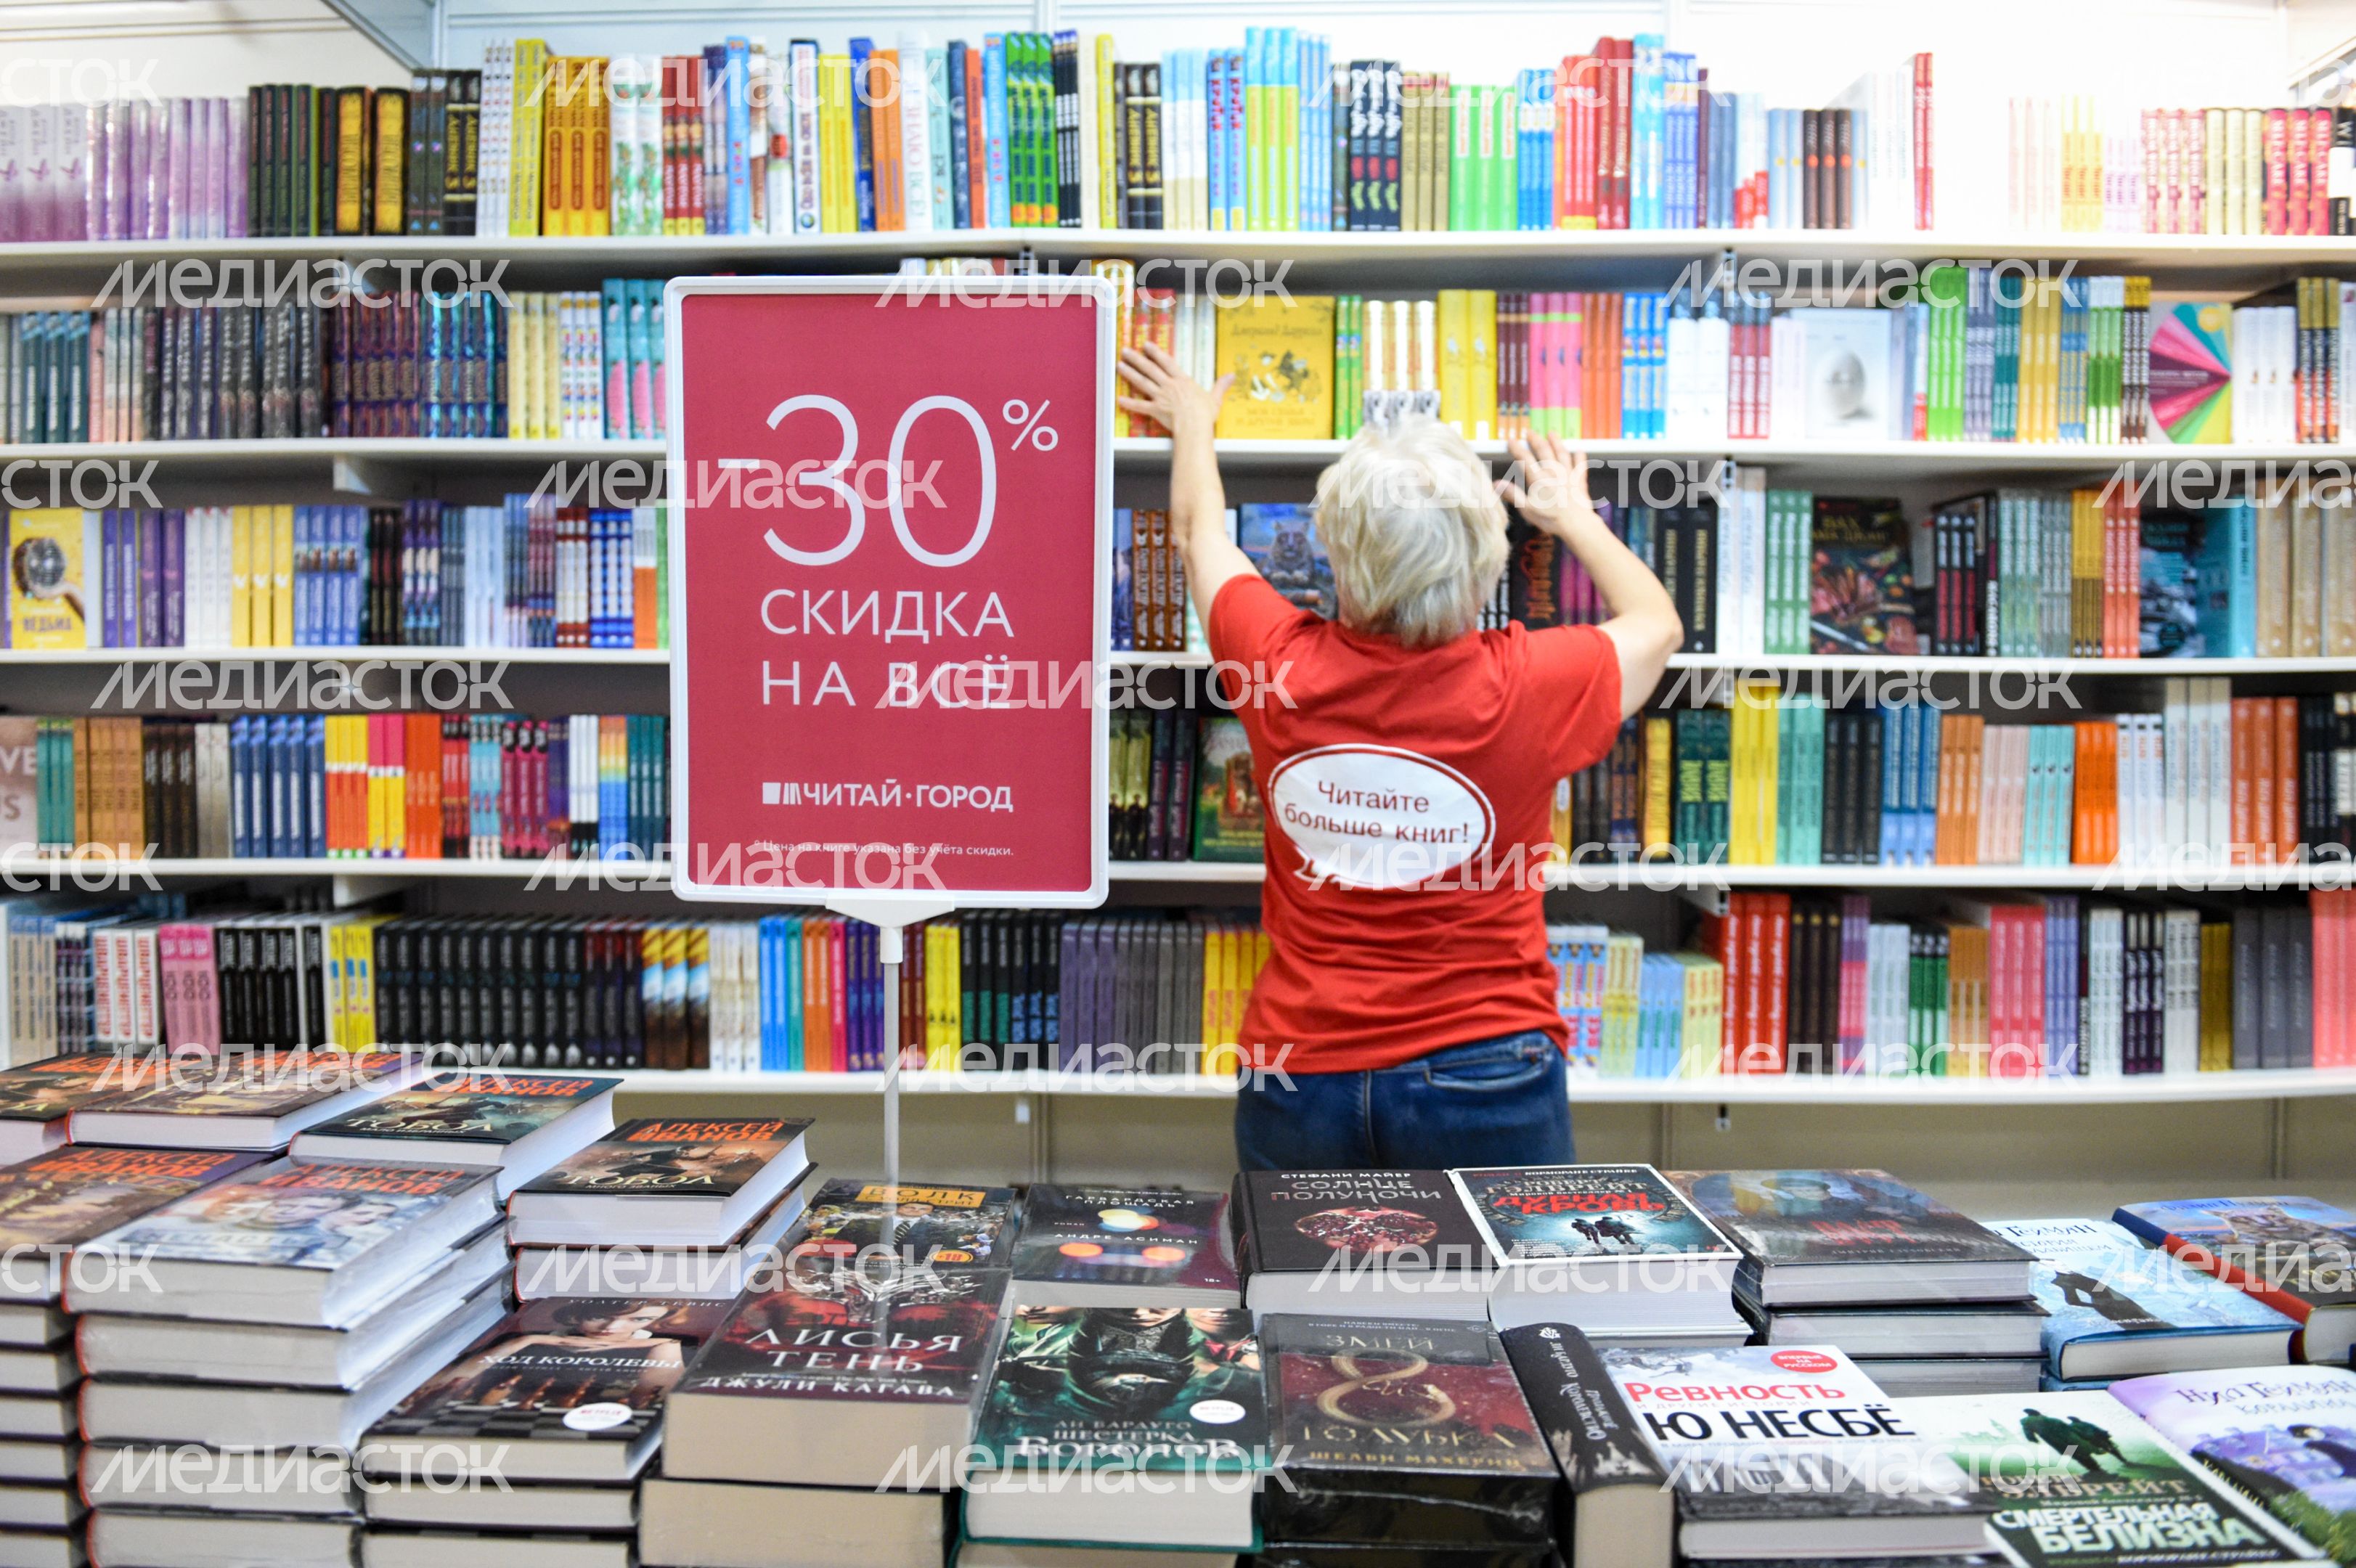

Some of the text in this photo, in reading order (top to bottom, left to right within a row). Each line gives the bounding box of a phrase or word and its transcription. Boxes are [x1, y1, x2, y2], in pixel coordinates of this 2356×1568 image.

[761, 589, 1014, 644] СКИДКА
[762, 654, 1011, 709] НА ВСЁ
[1318, 780, 1430, 814] Читайте
[1284, 802, 1470, 845] больше книг!
[764, 841, 794, 852] Цена
[855, 845, 901, 855] указана
[905, 844, 926, 853] без
[929, 844, 963, 855] учёта
[966, 847, 1014, 857] скидки.
[344, 1118, 494, 1132] ТОБОЛ
[641, 1120, 784, 1133] АЛЕКСЕЙ
[627, 1130, 775, 1142] ИВАНОВ
[64, 1149, 238, 1167] АЛЕКСЕЙ
[26, 1160, 212, 1178] ИВАНОВ
[293, 1163, 465, 1183] АЛЕКСЕЙ
[256, 1173, 445, 1196] ИВАНОВ
[563, 1175, 716, 1186] ТОБОЛ
[1291, 1177, 1414, 1191] СОЛНЦЕ
[869, 1187, 975, 1201] ВОЛК
[1065, 1195, 1194, 1205] ГАРВАРДСКАЯ
[1271, 1191, 1442, 1204] ПОЛУНОЧИ
[1493, 1193, 1648, 1206] ДУРНАЯ
[1084, 1199, 1175, 1208] ПЛОЩАДЬ
[1522, 1201, 1665, 1215] КРОВЬ
[1124, 1236, 1198, 1244] АСИМАН
[744, 1328, 964, 1352] ЛИСЬЯ
[1325, 1333, 1434, 1350] ЗМЕЙ
[478, 1355, 682, 1369] ХОД КОРОЛЕВЫ
[767, 1349, 924, 1373] ТЕНЬ
[699, 1376, 955, 1397] ДЖУЛИ КАГАВА
[1642, 1403, 1917, 1441] Ю НЕСБЁ
[1053, 1429, 1198, 1443] ШЕСТЕРКА
[1310, 1451, 1395, 1463] ШЕЛБИ
[1992, 1501, 2220, 1530] СМЕРТЕЛЬНАЯ
[2031, 1518, 2268, 1554] БЕЛИЗНА
